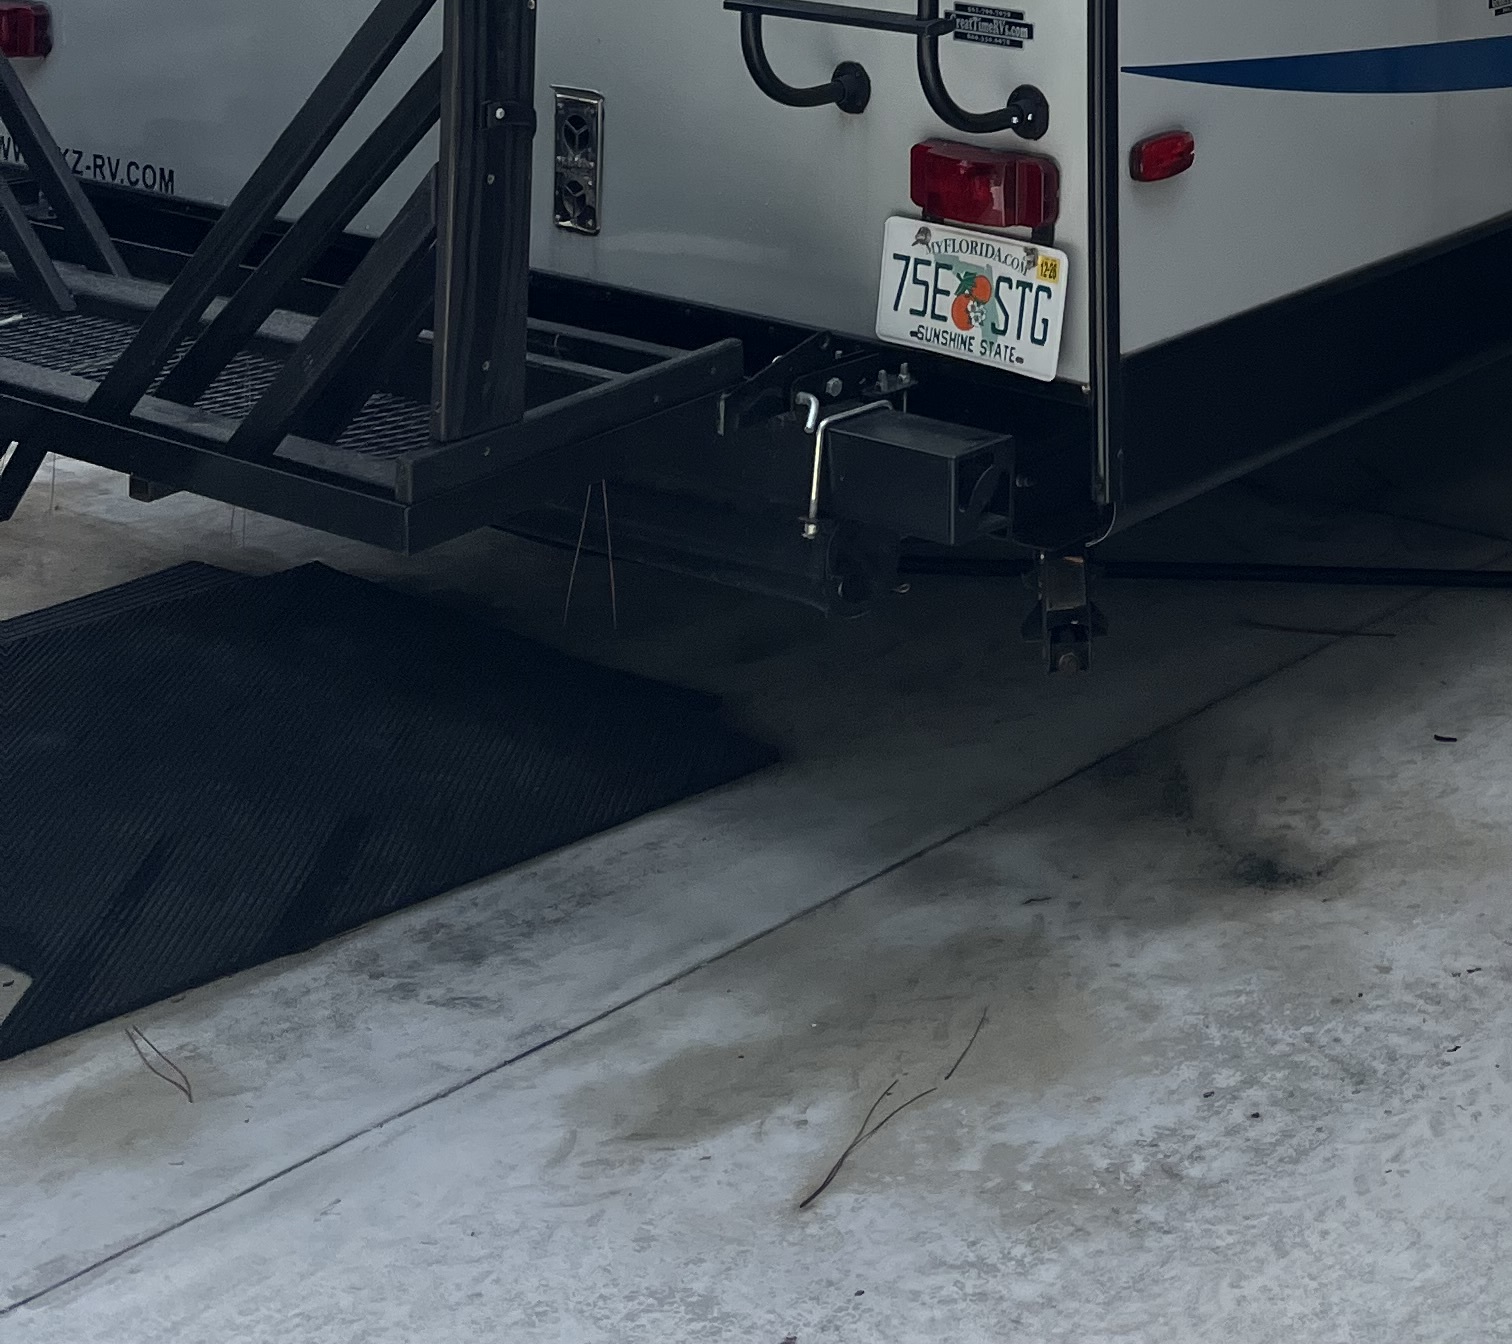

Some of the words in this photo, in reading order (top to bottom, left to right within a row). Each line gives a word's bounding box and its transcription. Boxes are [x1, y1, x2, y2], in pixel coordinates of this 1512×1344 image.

[893, 253, 953, 322] 75E
[991, 275, 1052, 346] STG
[917, 324, 975, 353] SUNSHINE
[979, 339, 1016, 363] STATE
